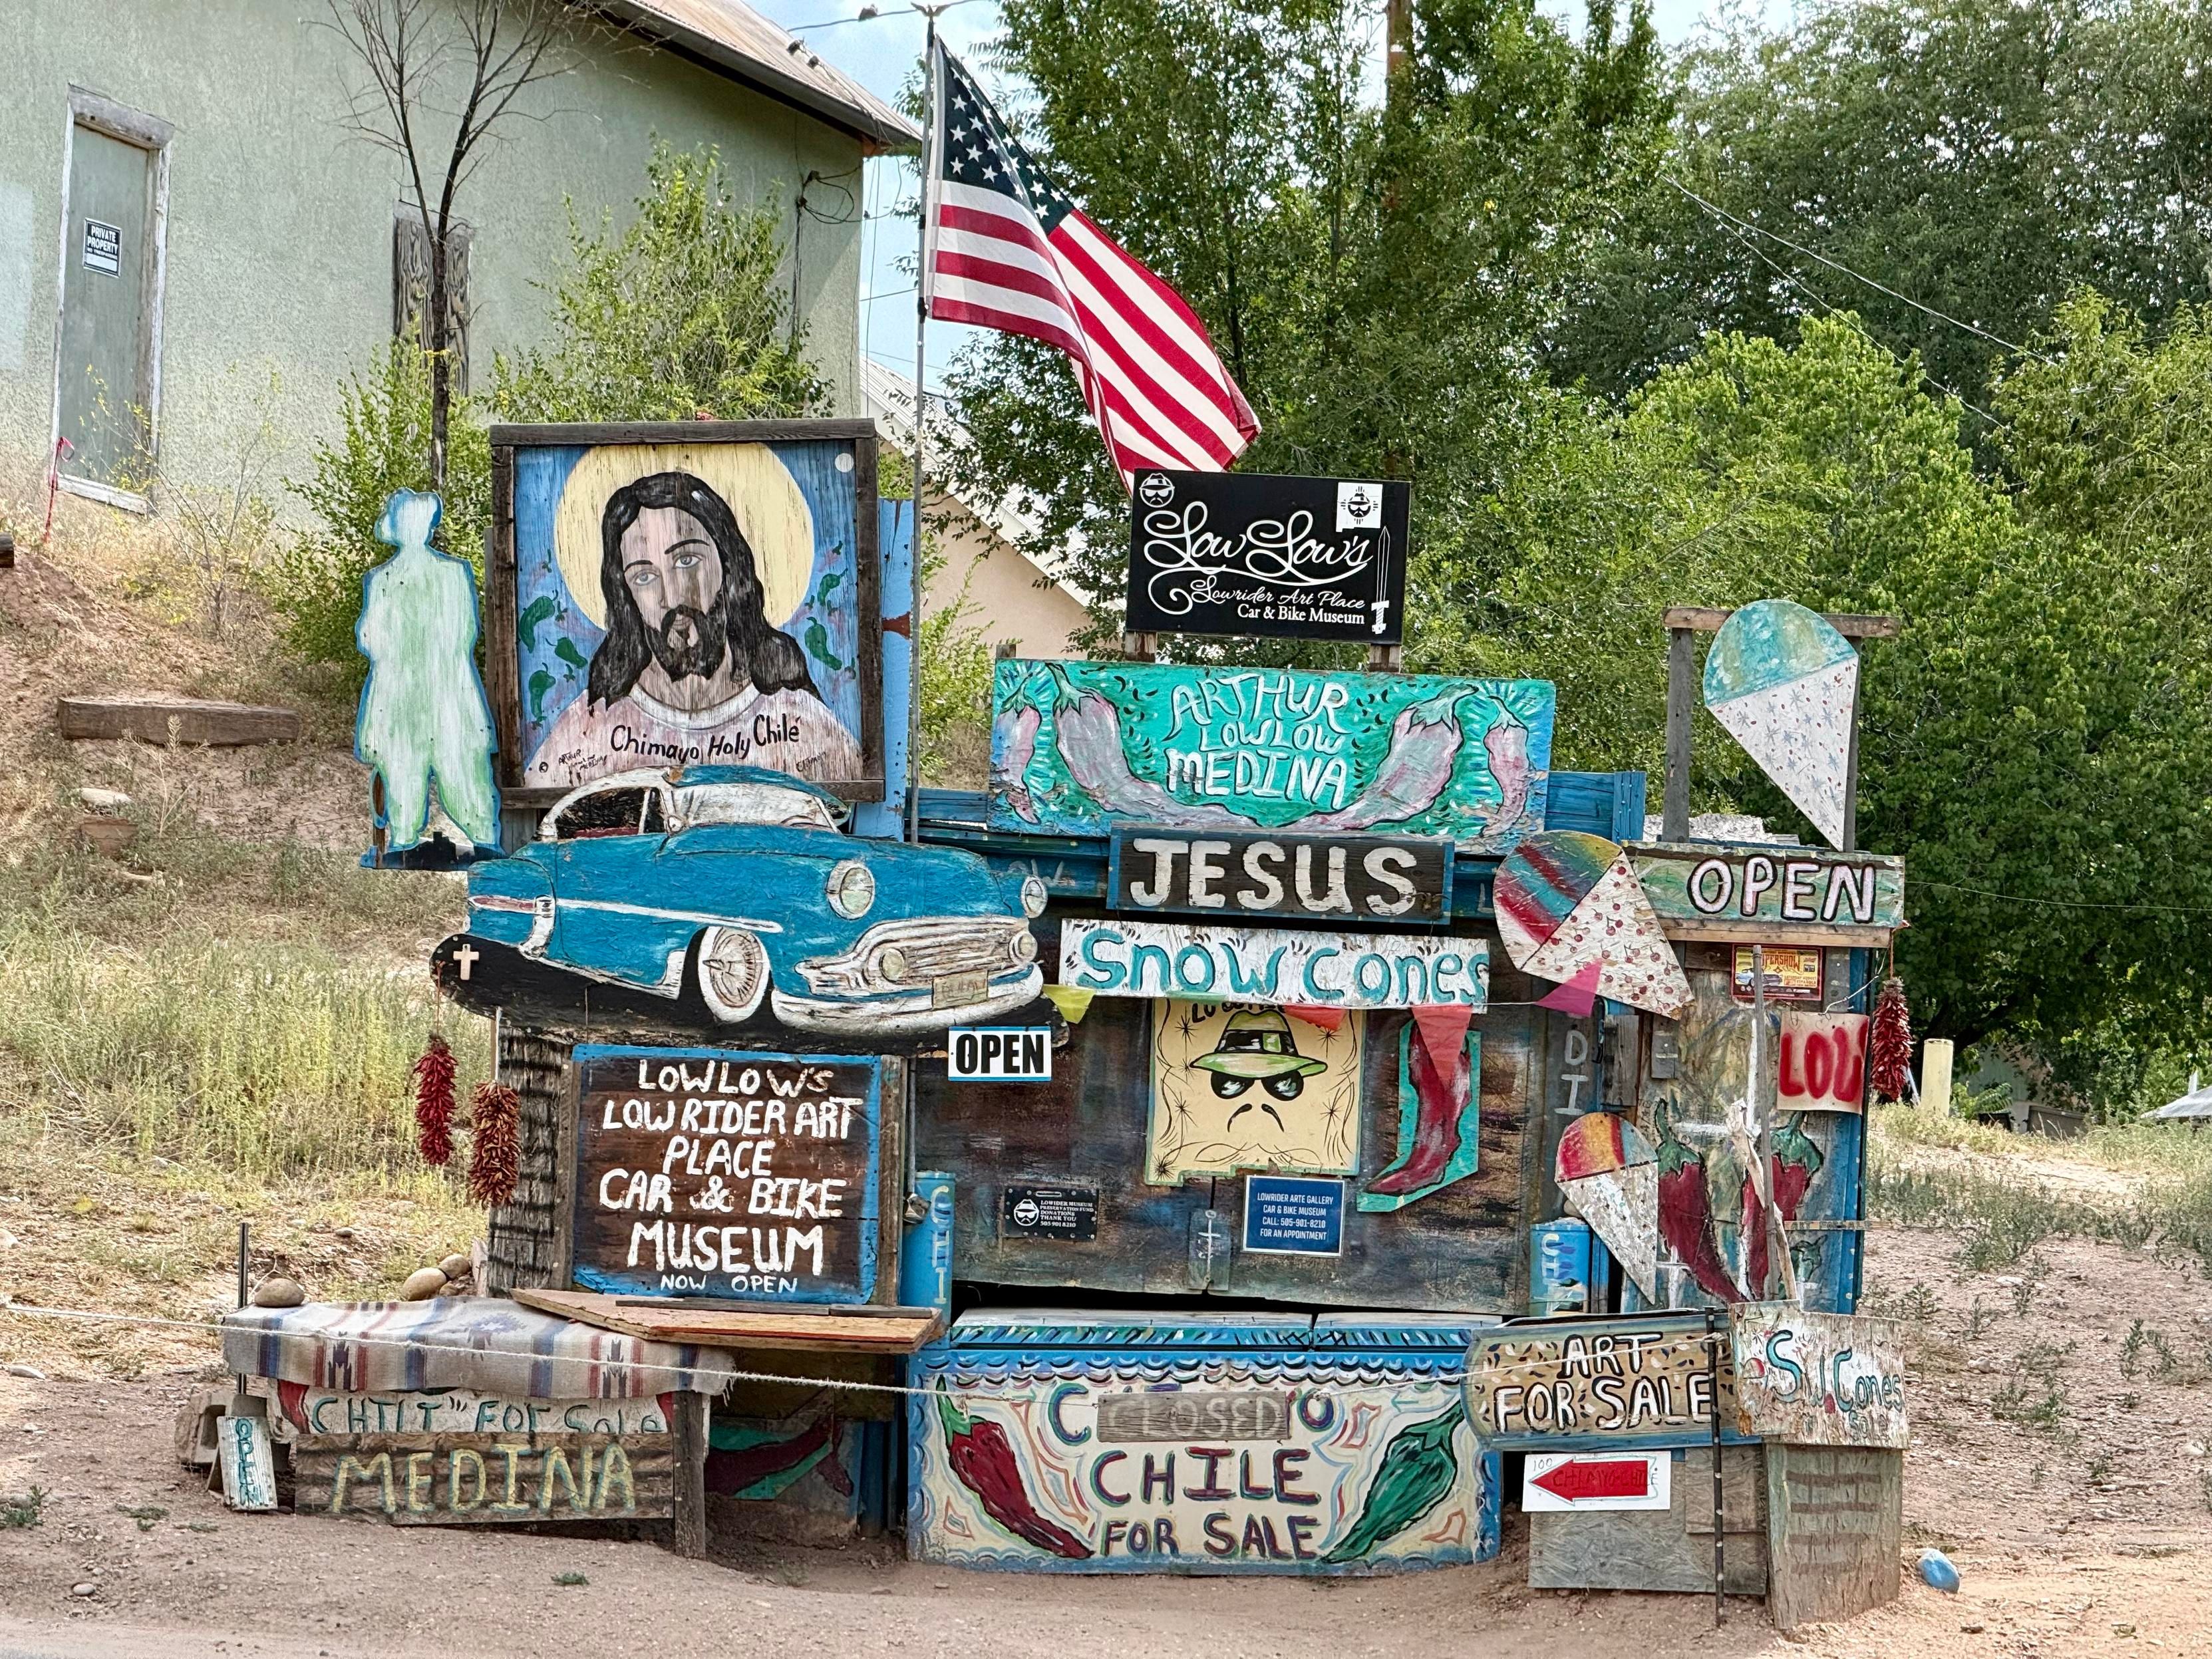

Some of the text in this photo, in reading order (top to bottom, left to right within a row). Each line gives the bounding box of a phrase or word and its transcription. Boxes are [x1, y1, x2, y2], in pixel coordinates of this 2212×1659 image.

[87, 235, 118, 254] PROPERTY
[90, 226, 117, 243] PRIVATE
[1189, 575, 1366, 609] Lowrider Art Place
[1237, 604, 1365, 625] Car & Bike Museum
[1163, 674, 1350, 742] ARTHUR
[611, 725, 699, 763] Chimayo
[709, 732, 750, 760] Holy
[1168, 748, 1347, 810] MEDINA
[1130, 838, 1418, 917] JESUS
[1687, 853, 1877, 923] OPEN
[955, 1032, 1045, 1074] OPEN
[794, 1097, 863, 1139] ART
[663, 1135, 776, 1179] PLACE
[599, 1168, 847, 1219] CAR & BIKE
[1257, 1193, 1289, 1202] LOWRIDER
[1307, 1195, 1333, 1205] GALLERY
[1263, 1205, 1275, 1213] CAR
[1283, 1206, 1297, 1215] BIKE
[1299, 1207, 1326, 1216] MUSEUM
[1260, 1228, 1271, 1237] FOR
[1283, 1230, 1327, 1240] APPOINTMENT
[1262, 1217, 1326, 1228] CALL: 505-901-8210
[627, 1221, 823, 1276] MUSEUM
[660, 1275, 798, 1293] NOW OPEN
[1561, 1332, 1662, 1378] ART
[1108, 1396, 1283, 1439] CLOSED
[1493, 1375, 1712, 1433] FOR SALE
[333, 1442, 635, 1515] MEDINA
[1090, 1447, 1321, 1507] CHILE
[1534, 1458, 1553, 1471] 100
[1100, 1513, 1322, 1561] FOR SALE
